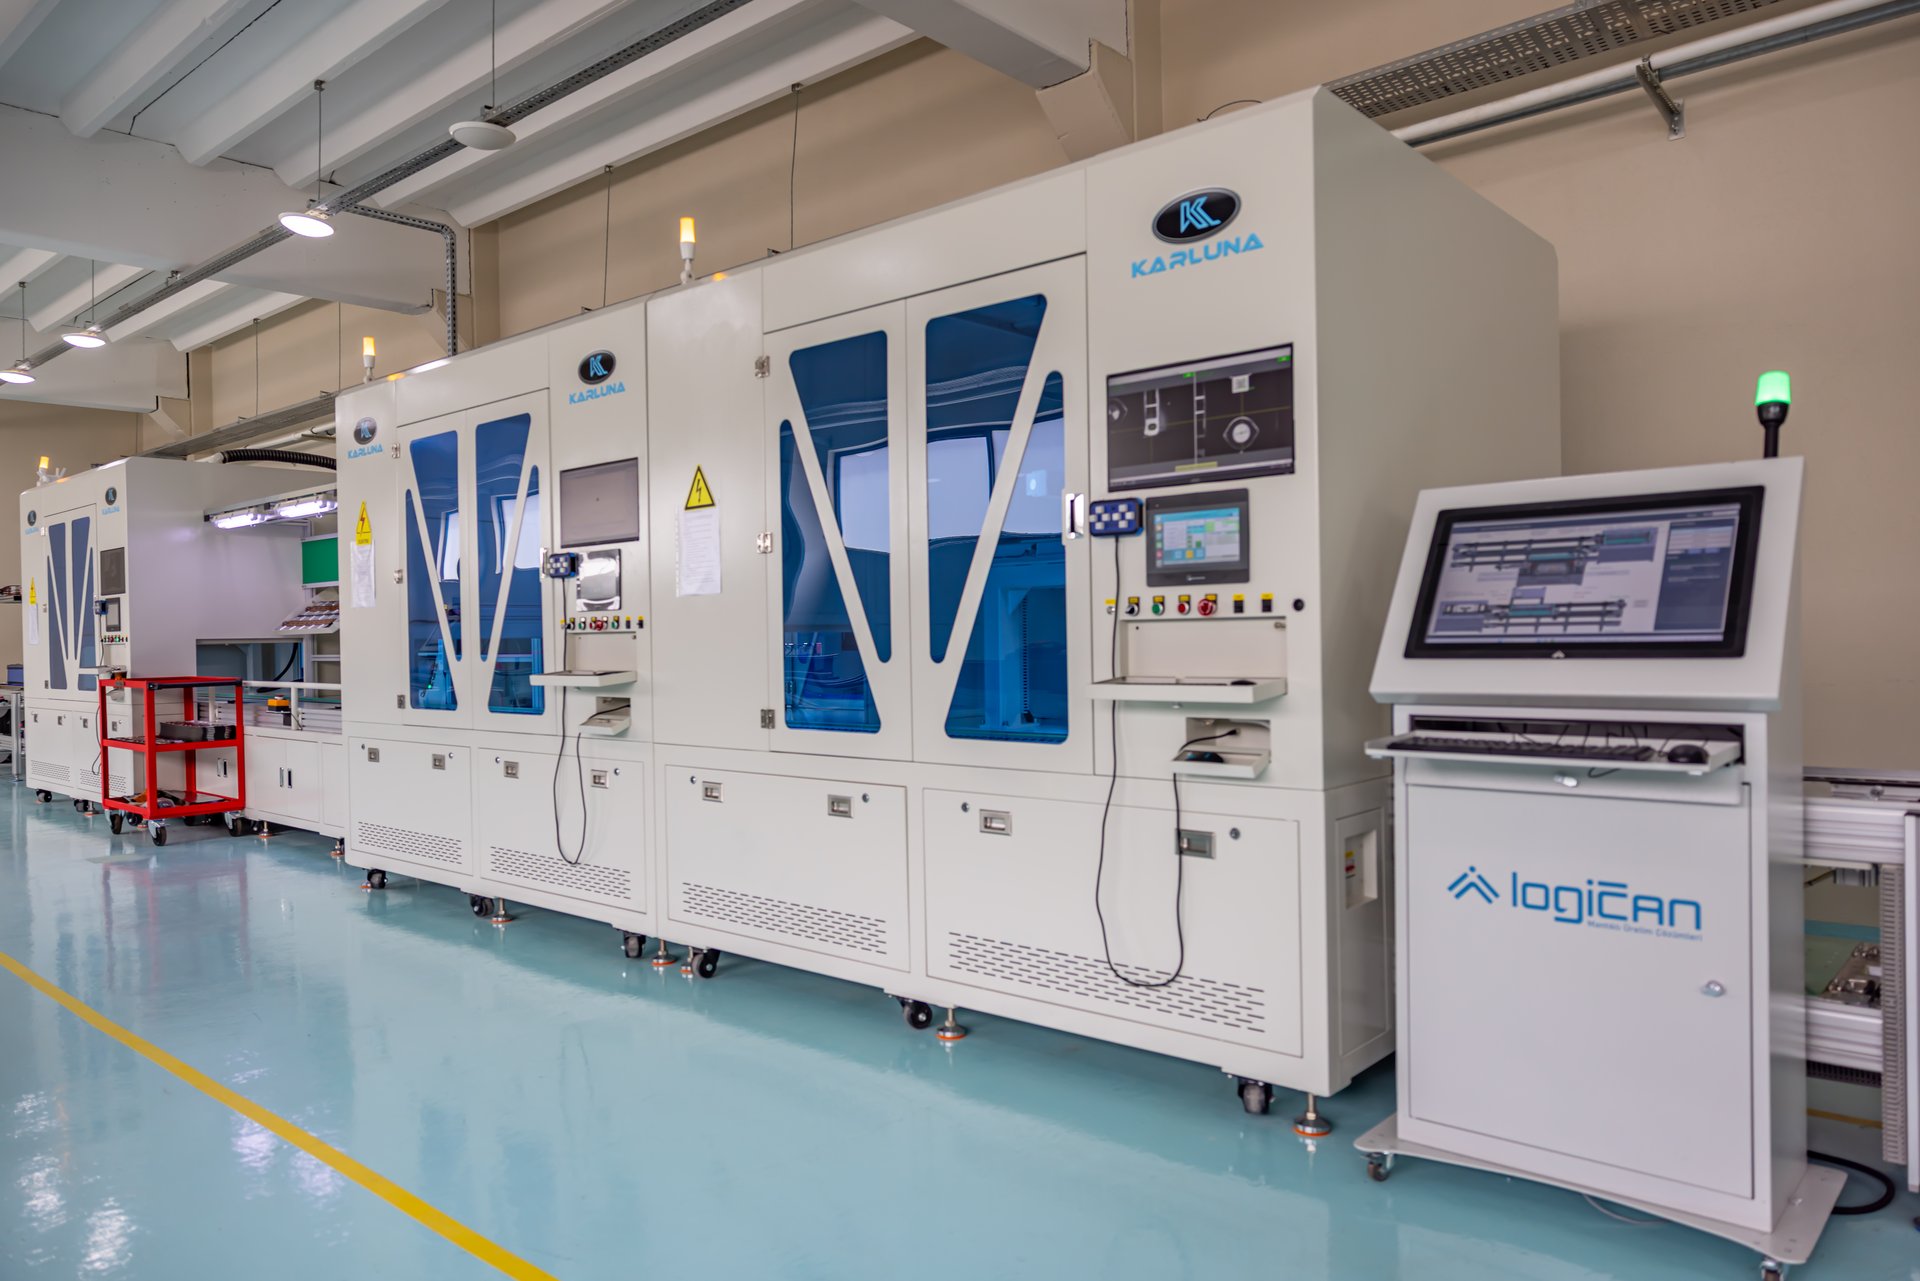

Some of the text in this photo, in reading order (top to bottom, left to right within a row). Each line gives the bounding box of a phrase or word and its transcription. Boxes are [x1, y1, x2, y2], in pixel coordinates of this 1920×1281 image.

[1131, 232, 1264, 279] KARLUNA
[568, 381, 626, 405] KARLUNA
[347, 443, 384, 459] KARLUNA
